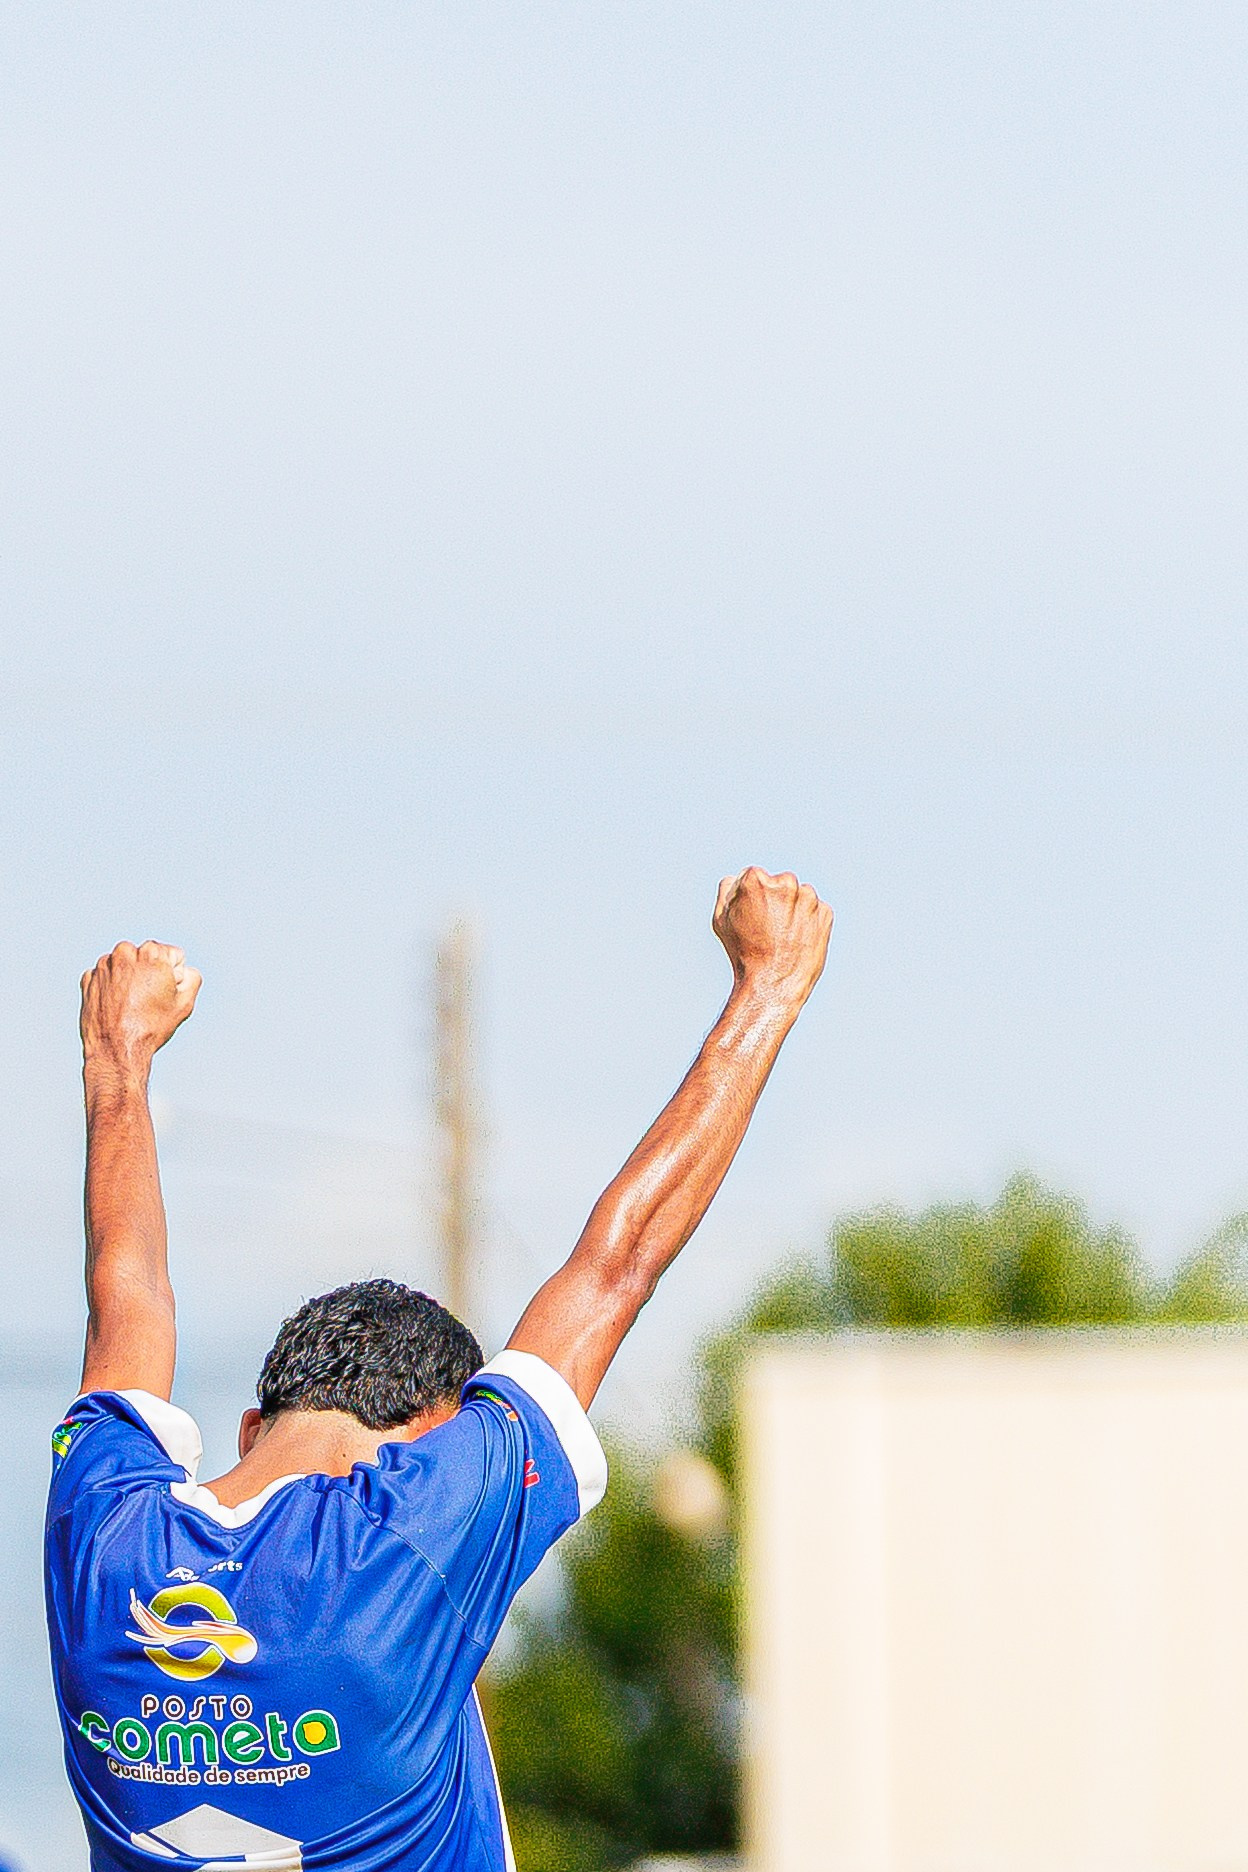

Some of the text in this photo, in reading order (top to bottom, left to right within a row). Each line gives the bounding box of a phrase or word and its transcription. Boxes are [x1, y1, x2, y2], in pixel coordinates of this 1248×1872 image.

[141, 1693, 253, 1720] POSTO
[78, 1709, 341, 1765] cometa
[108, 1757, 310, 1786] Qualidade de sempre
